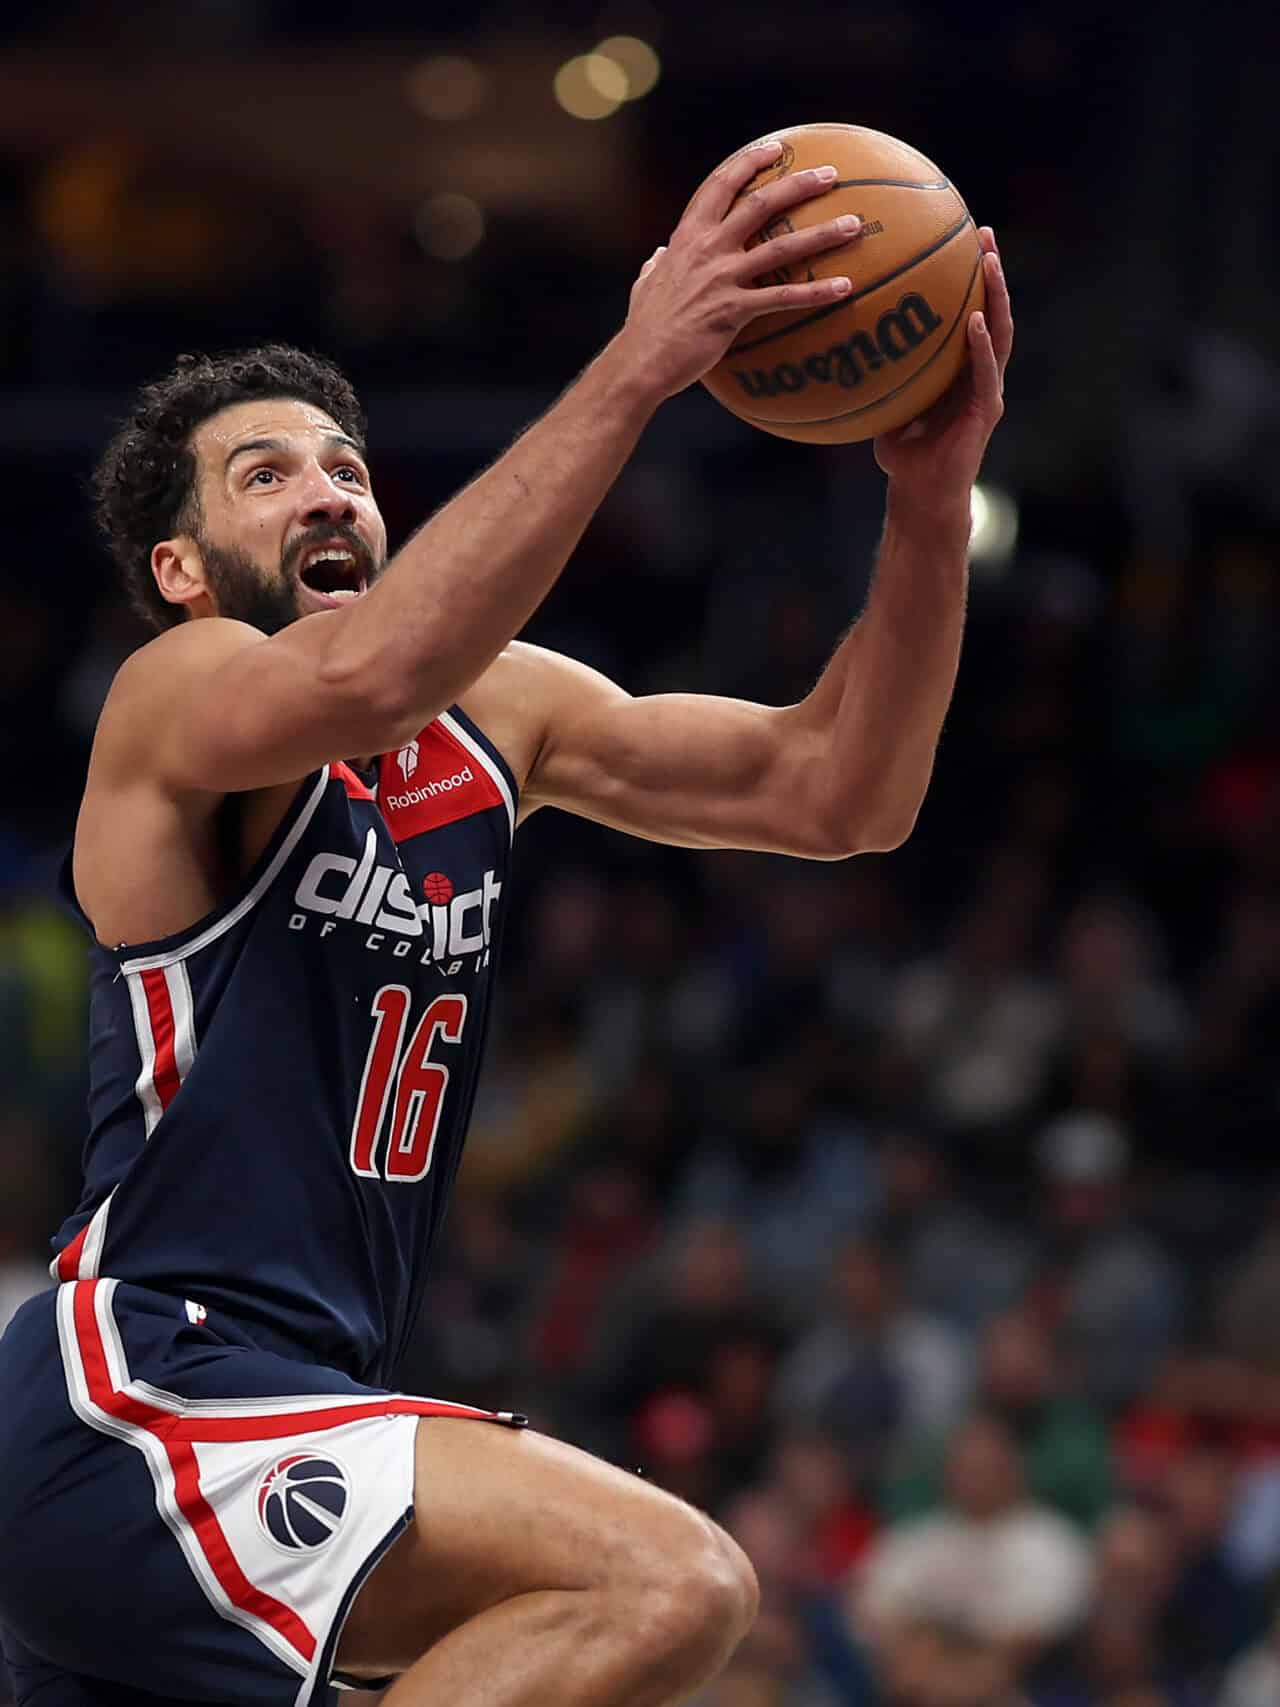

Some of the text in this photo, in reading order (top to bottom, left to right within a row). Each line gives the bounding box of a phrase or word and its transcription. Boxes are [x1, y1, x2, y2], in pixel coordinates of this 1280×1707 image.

[732, 292, 943, 397] Wilson
[386, 765, 474, 811] Robinhood
[288, 913, 336, 937] OF
[349, 983, 468, 1183] 16
